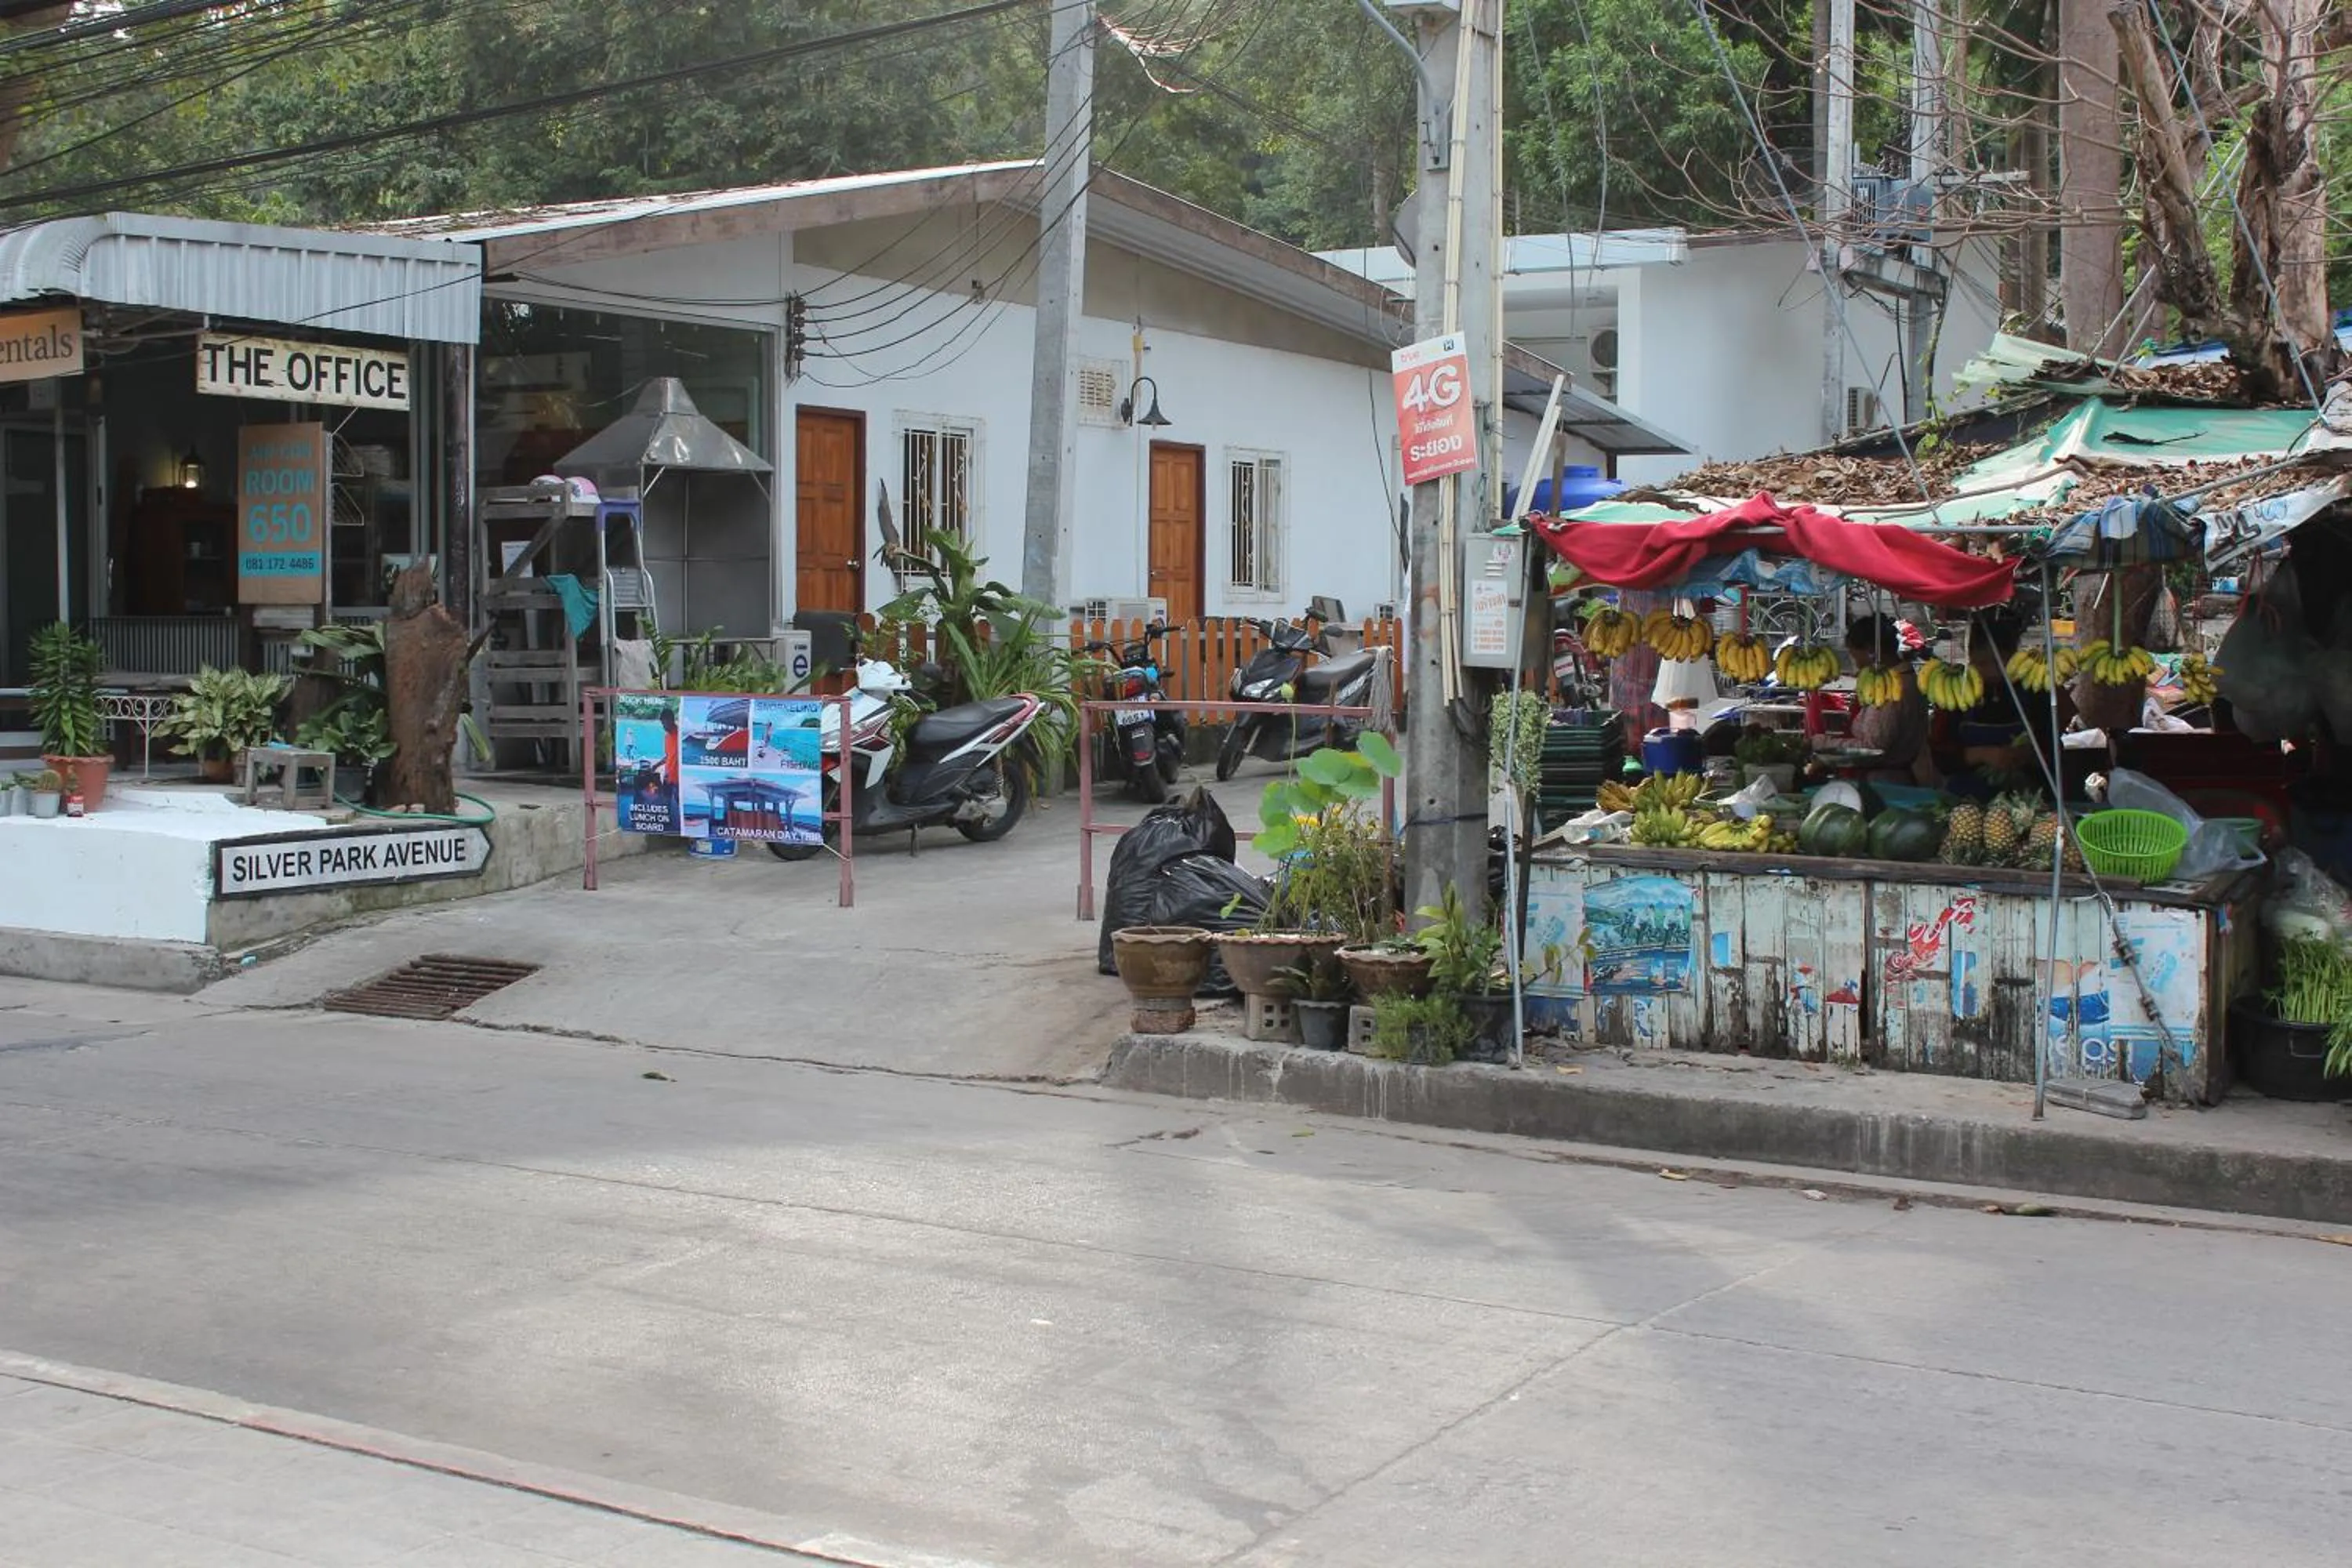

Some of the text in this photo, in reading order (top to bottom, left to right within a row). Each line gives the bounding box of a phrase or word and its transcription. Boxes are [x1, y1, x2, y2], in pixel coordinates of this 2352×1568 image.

[202, 343, 406, 400] THE OFFICE
[1402, 365, 1462, 412] 4G
[1410, 434, 1463, 462] ระยอง
[245, 469, 316, 496] ROOM
[249, 503, 311, 543] 650
[268, 557, 285, 570] 172
[700, 755, 746, 766] 1500 BAHT
[630, 804, 669, 814] INCLUDES
[630, 812, 670, 822] LUNCH ON
[636, 822, 664, 832] BOARD
[717, 827, 775, 839] CATAMARAN
[777, 829, 796, 840] DAY
[232, 838, 466, 882] SILVER PARK AVENUE
